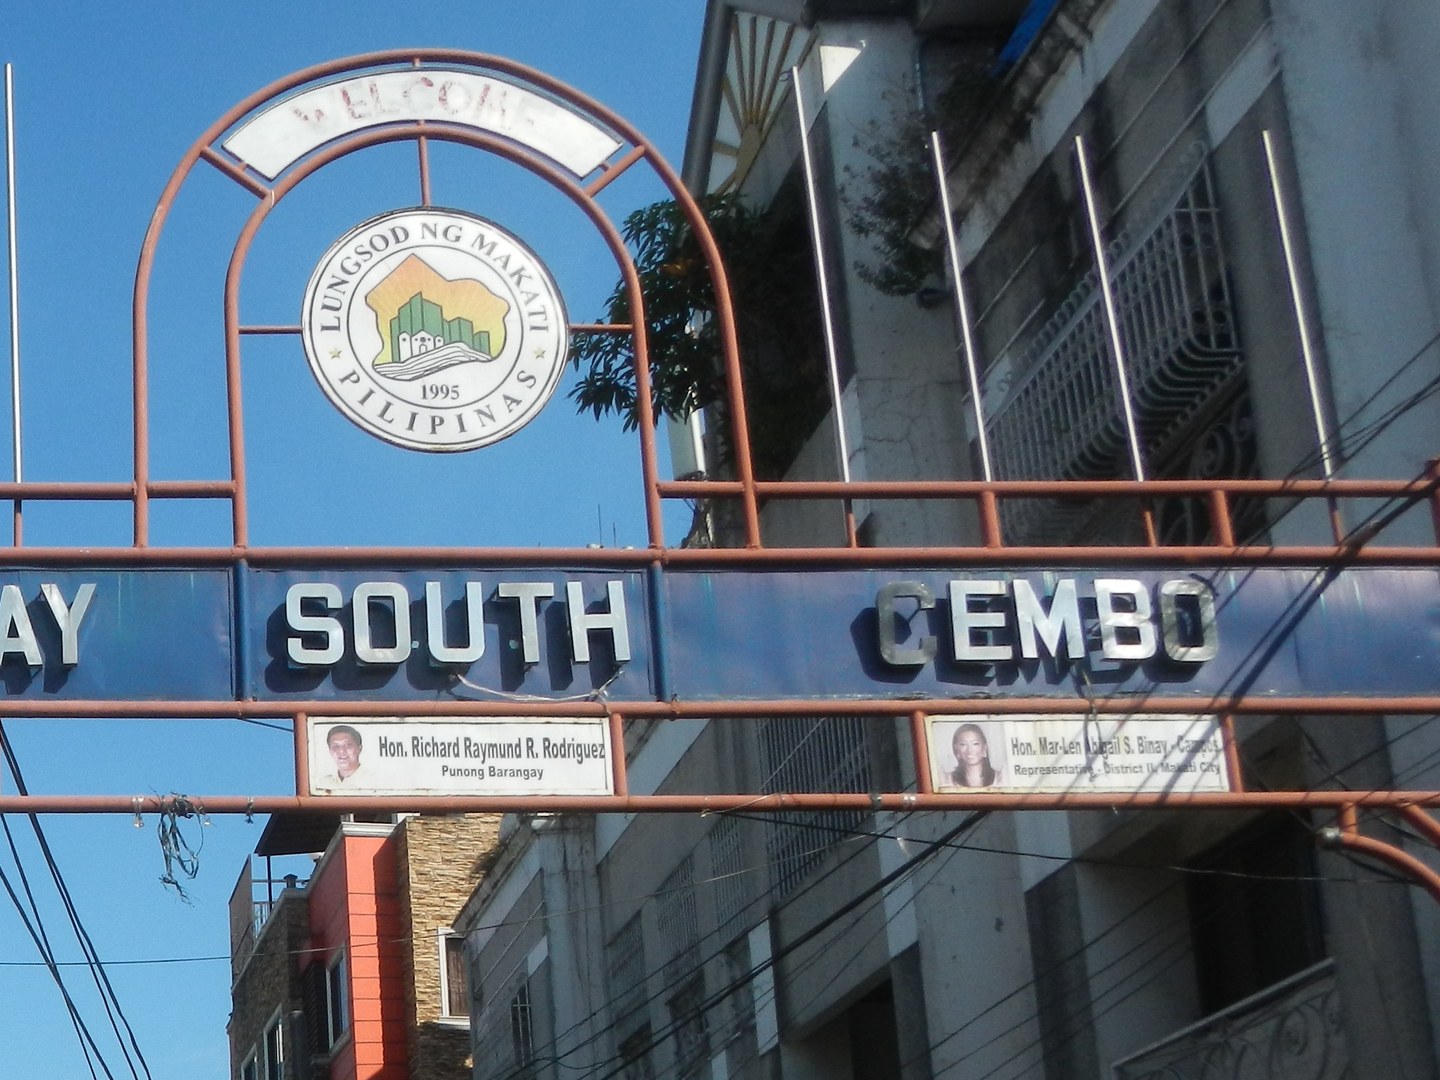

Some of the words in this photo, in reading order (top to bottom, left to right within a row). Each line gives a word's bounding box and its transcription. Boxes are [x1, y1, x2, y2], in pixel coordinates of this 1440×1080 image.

[292, 76, 536, 130] WELCOM
[320, 225, 410, 332] LUNGSOD
[420, 222, 463, 243] NG
[471, 232, 550, 333] MAKATI
[338, 369, 537, 435] PILIPINAS
[421, 384, 460, 400] 1995
[285, 580, 631, 665] SOUTH
[875, 578, 1220, 666] CEMBO
[379, 736, 408, 758] Hon.
[412, 736, 460, 758] Richard
[464, 737, 522, 764] Raymund
[526, 737, 539, 758] R.
[543, 737, 605, 764] Rodriguez
[1011, 736, 1036, 756] Hon.
[1038, 736, 1082, 756] Mar-Len
[1085, 736, 1121, 759] Abgail
[1124, 736, 1135, 755] S.
[1137, 736, 1168, 759] Binay
[442, 765, 485, 780] Punong
[488, 766, 544, 780] Barangay
[1161, 763, 1197, 774] Makati
[1200, 763, 1221, 776] City
